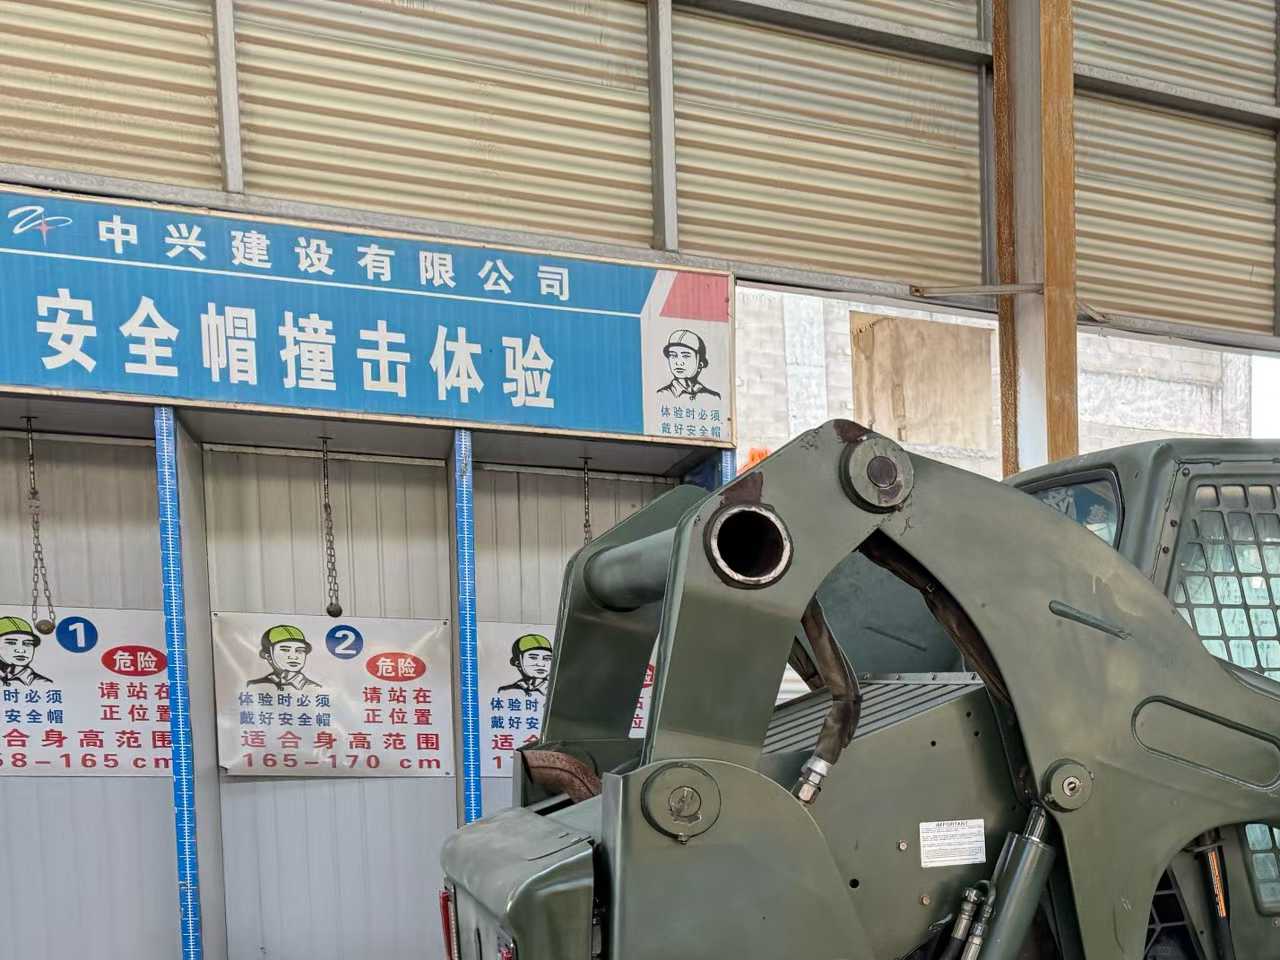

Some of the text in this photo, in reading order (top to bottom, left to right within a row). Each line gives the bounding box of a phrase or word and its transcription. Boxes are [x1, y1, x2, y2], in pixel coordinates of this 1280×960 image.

[98, 214, 570, 302] 中兴建设有限公司
[36, 287, 556, 409] 安全帽撞击体验
[661, 404, 721, 422] 体验时必须
[661, 422, 721, 438] 戴好安全帽
[68, 622, 86, 648] 1
[334, 630, 357, 655] 2
[112, 650, 159, 672] 危险
[376, 657, 417, 678] 危险
[3, 688, 64, 704] 时必须
[238, 691, 331, 709] 体验时必须
[362, 686, 433, 705] 请站在
[491, 697, 539, 713] 体验时
[5, 708, 65, 725] 安全帽
[239, 710, 331, 728] 戴好安全帽
[363, 707, 433, 726] 正位置
[491, 716, 539, 731] 戴好安
[2, 728, 173, 749] 合身高范围
[241, 730, 440, 751] 适合身高范围
[0, 753, 119, 769] 8-165
[242, 752, 441, 769] 165-170 cm
